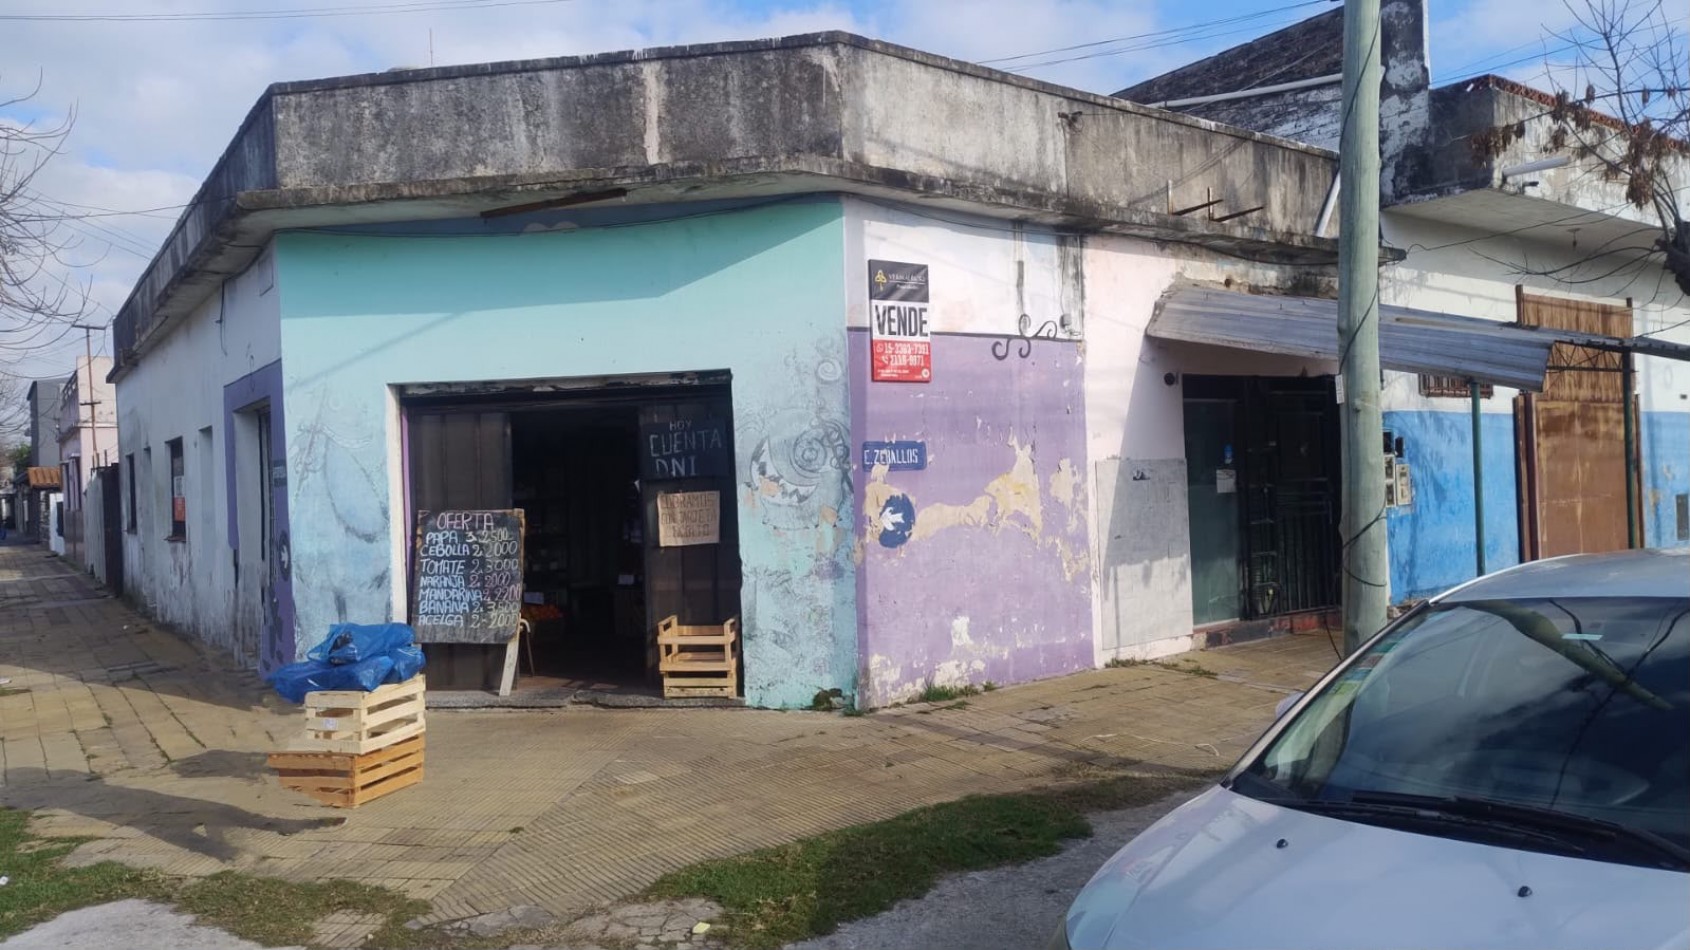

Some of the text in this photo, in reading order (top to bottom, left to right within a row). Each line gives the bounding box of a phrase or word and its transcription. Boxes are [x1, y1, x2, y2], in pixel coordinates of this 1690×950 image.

[875, 304, 929, 337] VENDE
[669, 420, 692, 431] HOY
[650, 428, 722, 457] CUENTA
[656, 455, 696, 477] DNI
[437, 512, 494, 530] OFERTA
[426, 530, 458, 544] PAPA
[420, 543, 470, 557] CEBOLLA
[420, 558, 466, 575] TOMATE
[420, 575, 465, 589] NARANJA
[418, 588, 483, 602] MANDARINA
[420, 601, 469, 614] BANANA
[418, 614, 464, 628] ACELGA
